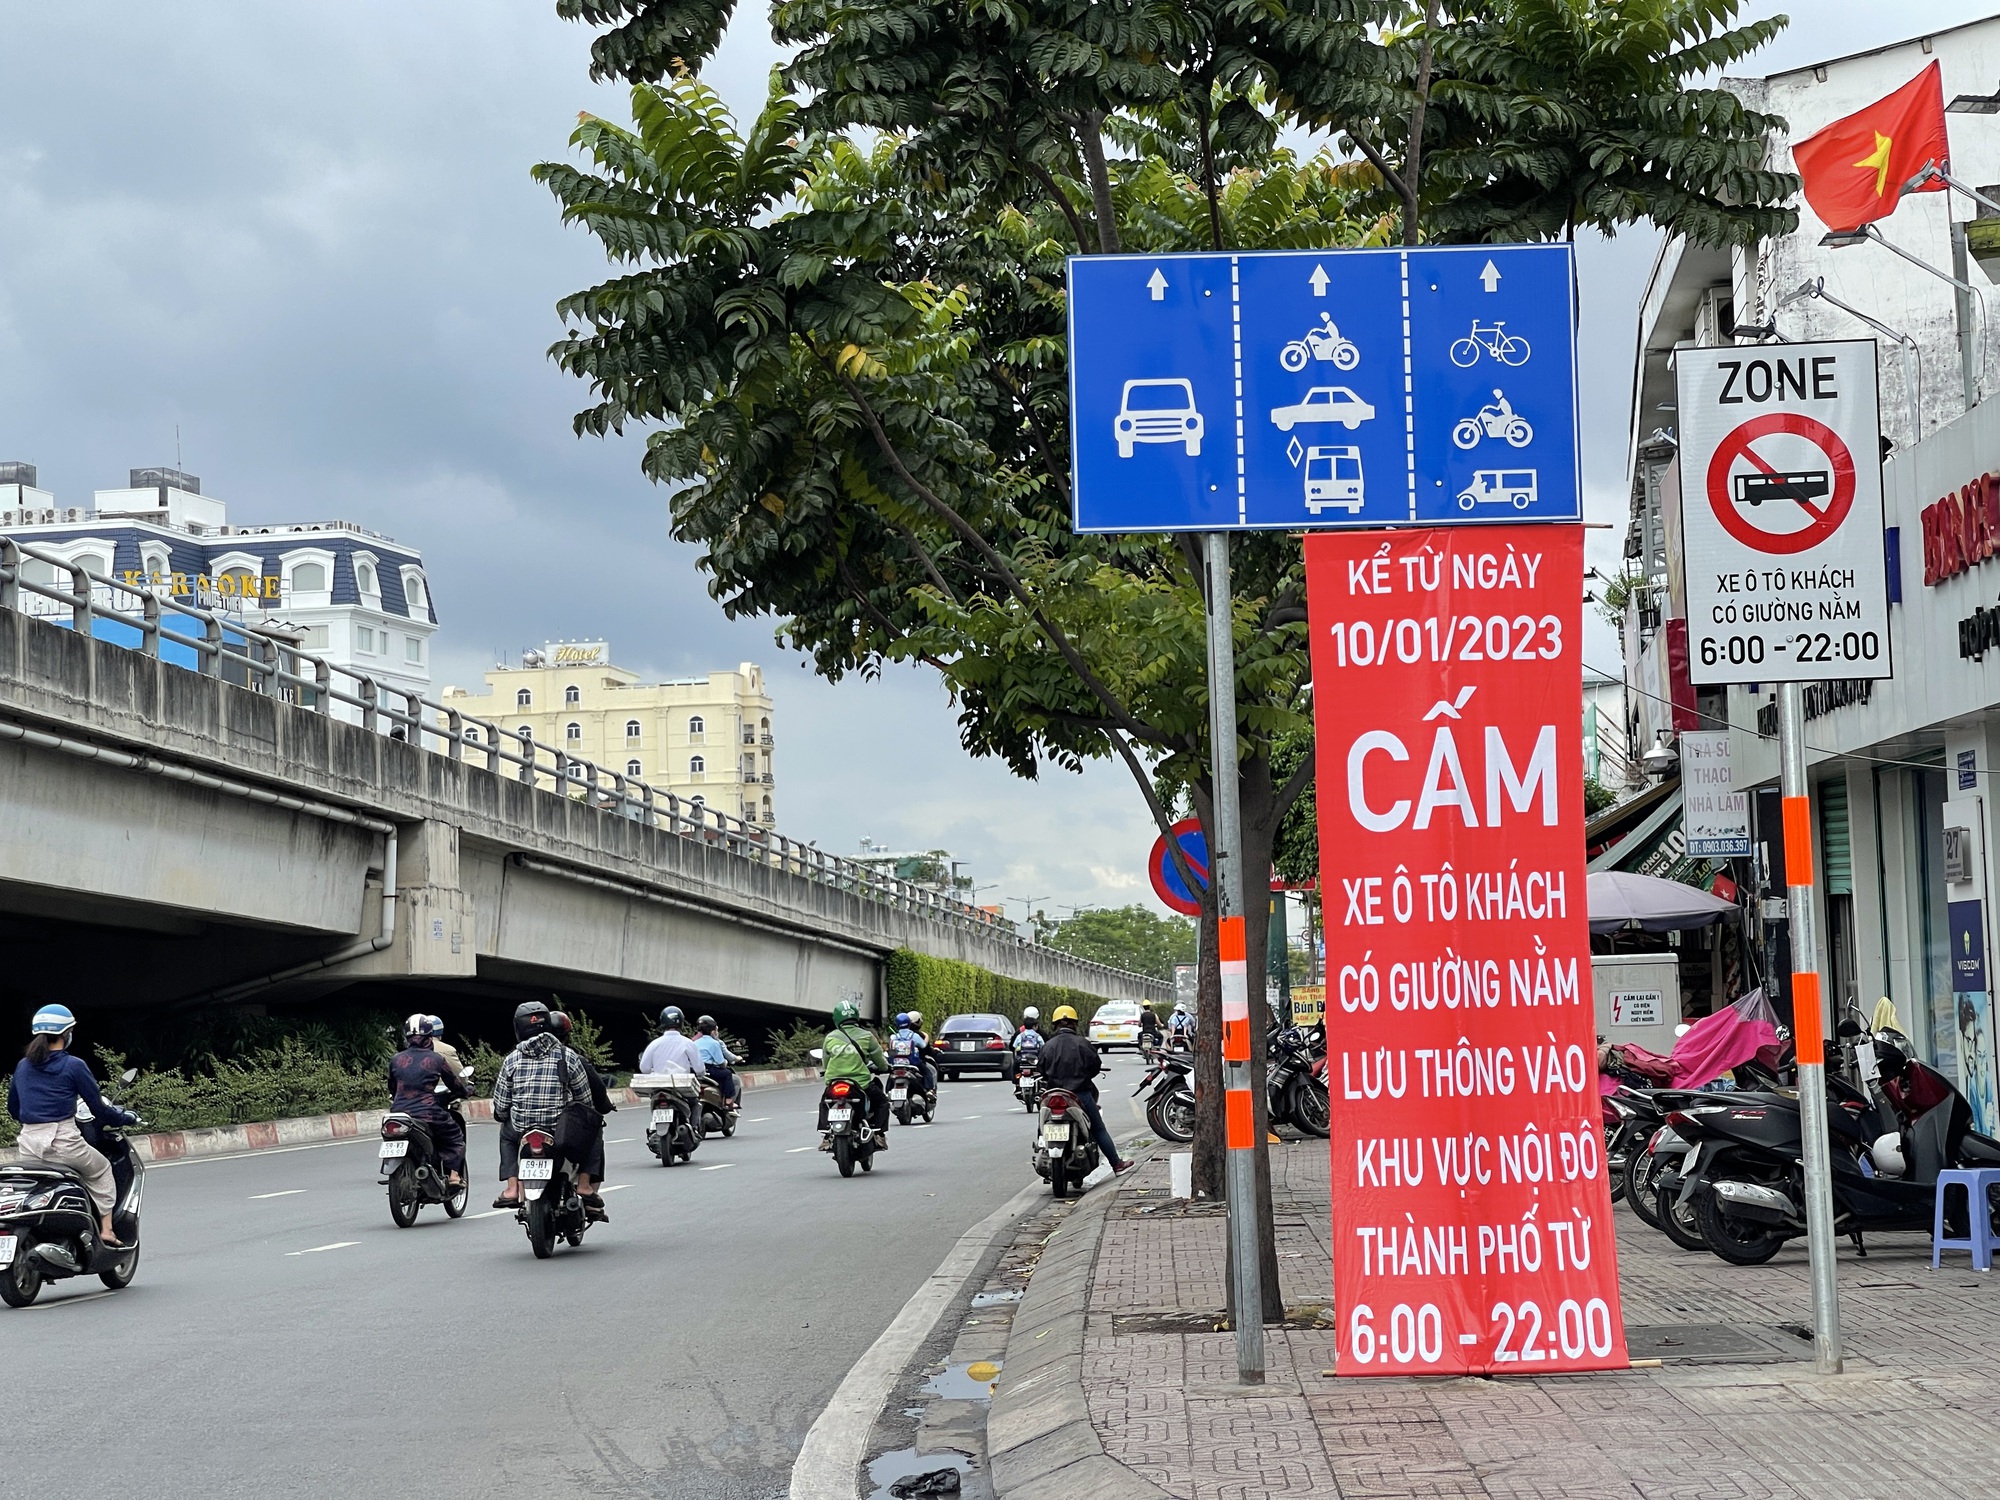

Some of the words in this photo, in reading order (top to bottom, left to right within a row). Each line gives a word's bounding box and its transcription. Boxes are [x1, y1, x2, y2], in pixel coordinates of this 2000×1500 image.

[1718, 357, 1838, 404] ZONE
[123, 570, 281, 599] KARAOKE
[1348, 542, 1391, 595] KỂ
[1399, 545, 1443, 593] TỪ
[1453, 543, 1542, 589] NGÀY
[1717, 573, 1740, 593] XE
[1745, 569, 1757, 592] Ô
[1762, 568, 1786, 591] TÔ
[1791, 564, 1855, 590] KHÁCH
[1712, 600, 1737, 624] CÓ
[1742, 597, 1813, 623] GIƯỜNG
[1819, 591, 1861, 620] NẰM
[553, 646, 601, 662] Hotel
[1331, 614, 1563, 667] 10/01/2023
[1700, 635, 1765, 666] 6:00
[1795, 631, 1879, 663] 22:00
[1347, 685, 1559, 833] CẤM
[1688, 792, 1713, 812] NHÀ
[1718, 791, 1744, 811] LÀM
[1703, 838, 1748, 853] 0903.036.397
[1946, 831, 1959, 859] 27
[1342, 877, 1384, 926] XE
[1392, 863, 1413, 924] Ô
[1420, 861, 1458, 922] TÔ
[1465, 858, 1566, 921] KHÁCH
[1339, 950, 1380, 1013] CÓ
[1389, 946, 1501, 1011] GIƯỜNG
[1509, 934, 1580, 1008] NẰM
[1294, 1001, 1314, 1013] Bún
[1342, 1045, 1407, 1100] LƯU
[1415, 1036, 1515, 1098] THÔNG
[1522, 1031, 1586, 1094] VÀO
[1357, 1138, 1424, 1188] KHU
[1431, 1131, 1492, 1198] VỰC
[1498, 1121, 1554, 1196] NỘI
[1559, 1119, 1598, 1182] ĐÔ
[1356, 1212, 1469, 1276] THÀNH
[1478, 1202, 1542, 1275] PHỐ
[1547, 1206, 1592, 1272] TỪ
[1351, 1303, 1443, 1365] 6:00
[1459, 1333, 1477, 1345] -
[1491, 1297, 1613, 1363] 22:00
